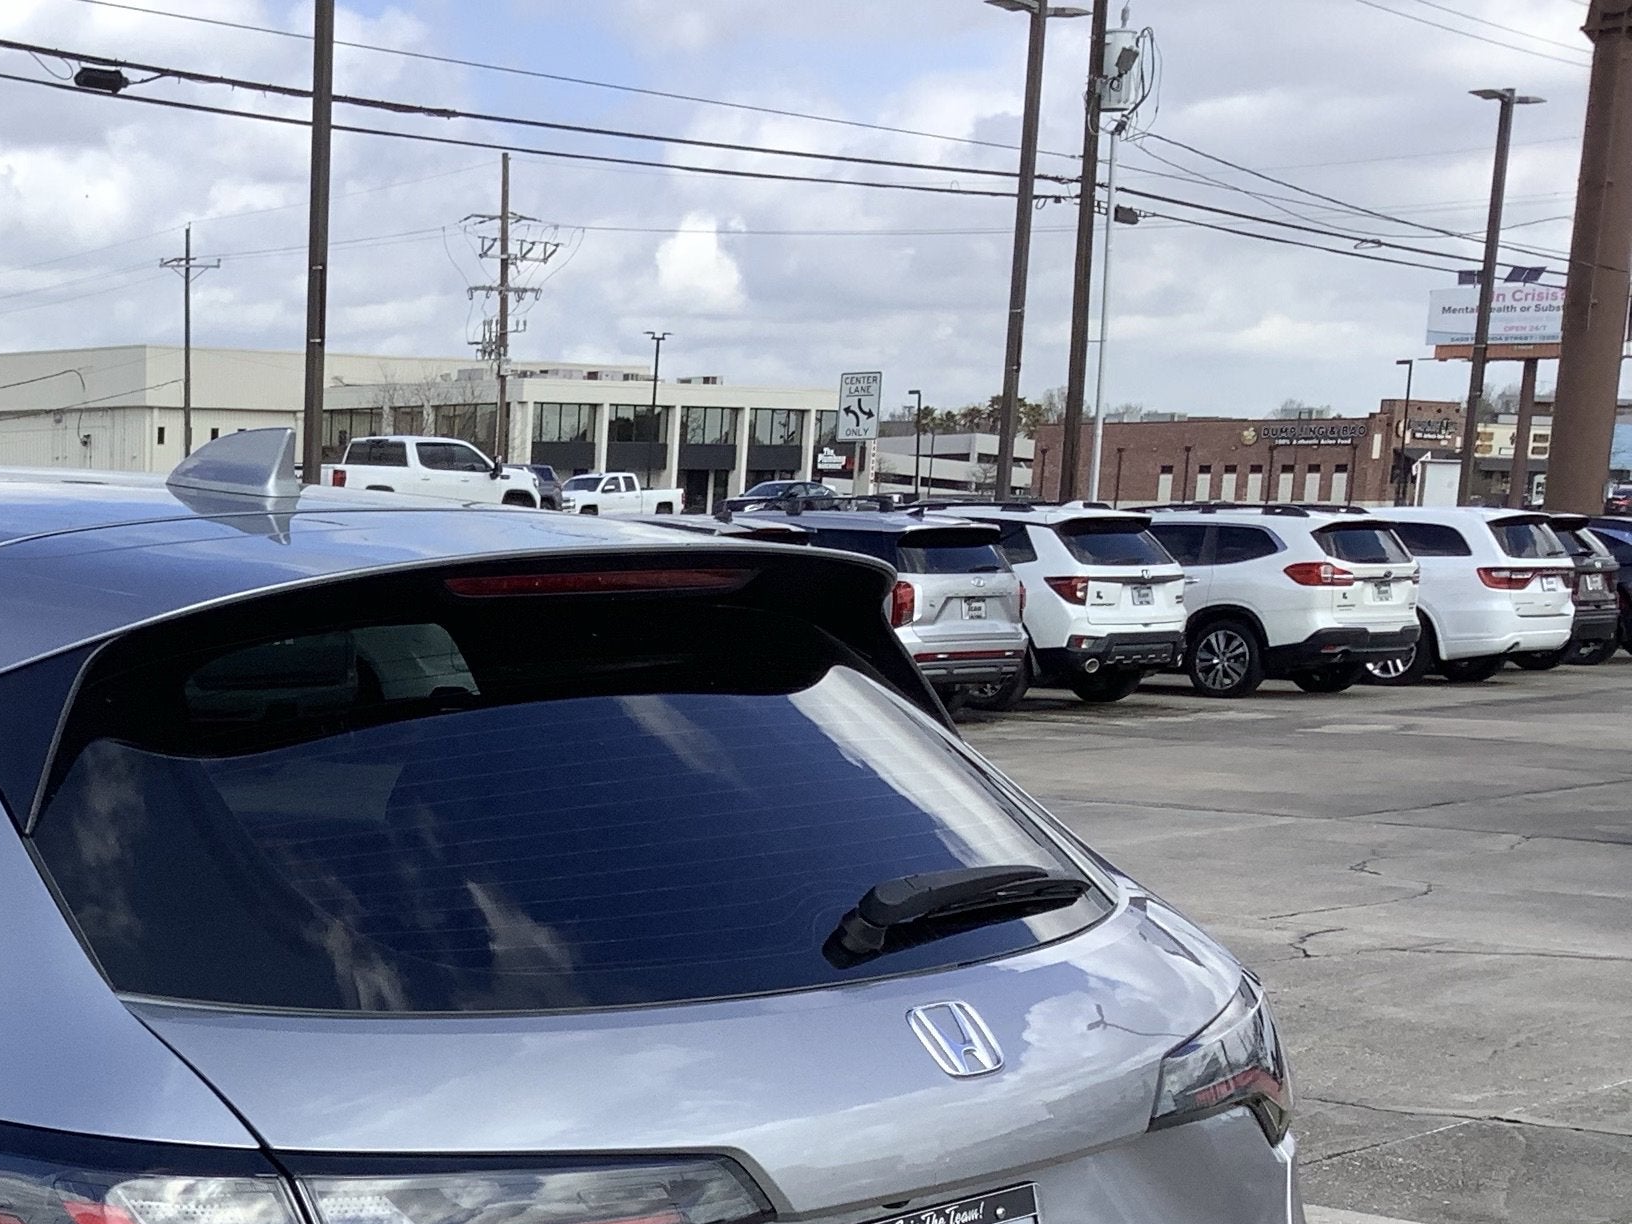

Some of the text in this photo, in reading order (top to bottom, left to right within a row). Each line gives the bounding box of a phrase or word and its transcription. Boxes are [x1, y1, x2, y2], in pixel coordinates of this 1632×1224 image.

[1520, 304, 1532, 313] or
[1534, 303, 1564, 313] Subs
[844, 375, 878, 386] CENTER
[848, 385, 872, 395] LANE
[845, 427, 871, 437] ONLY
